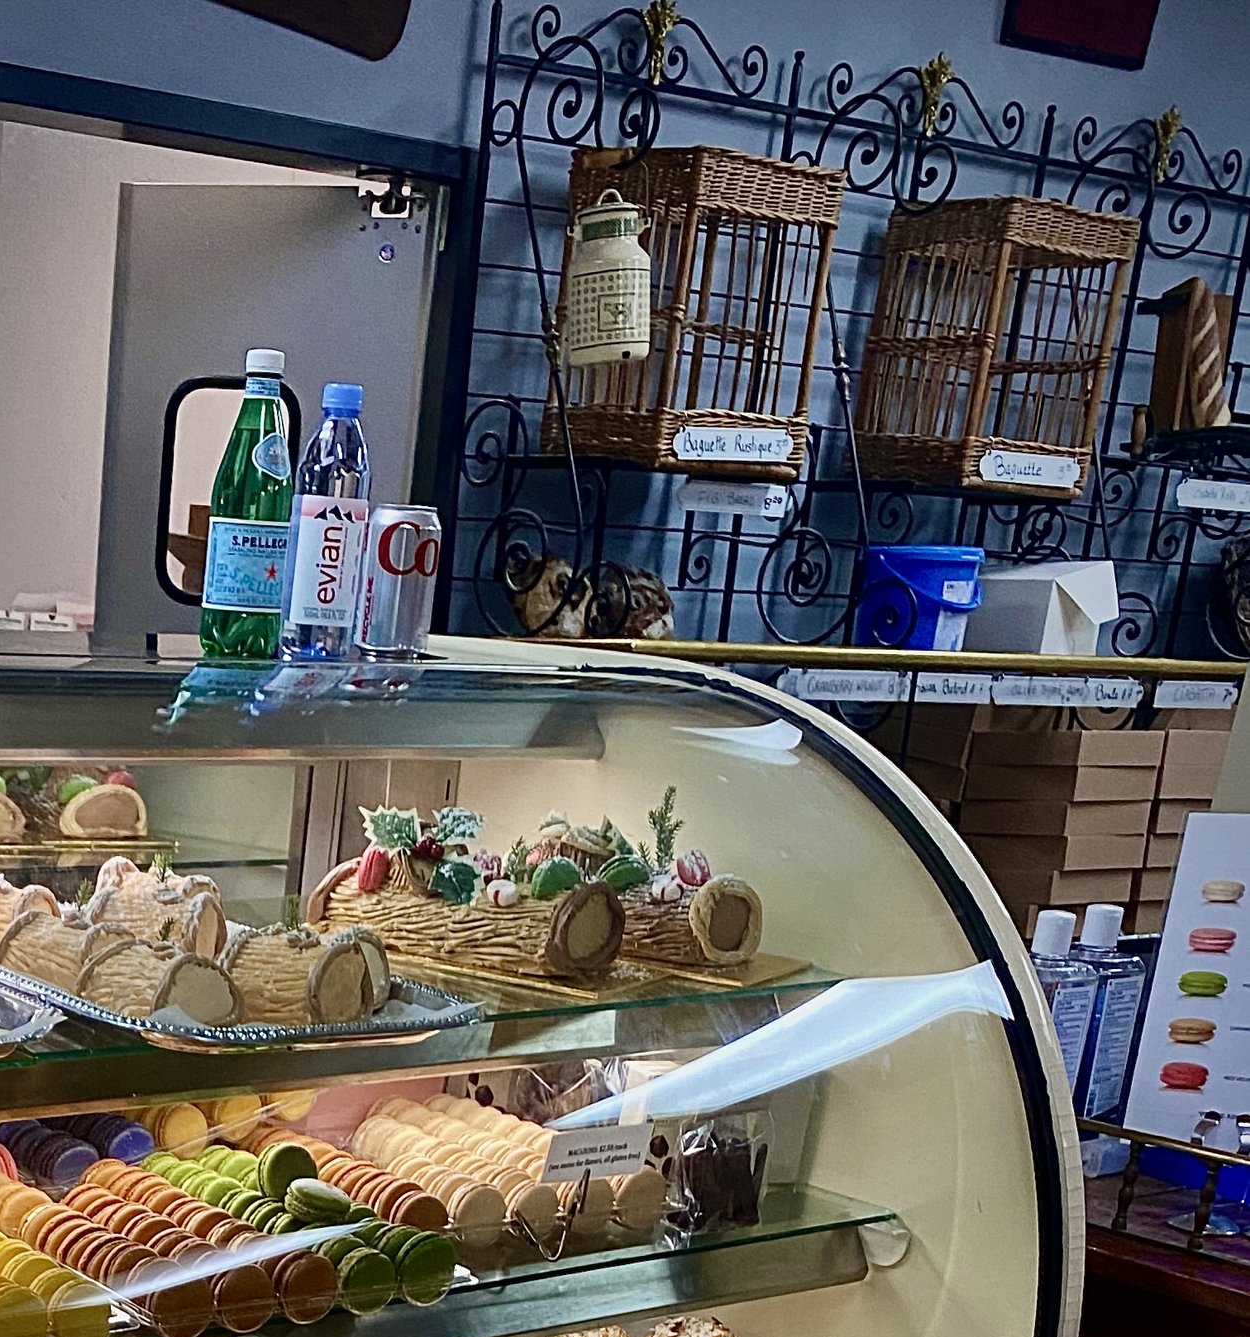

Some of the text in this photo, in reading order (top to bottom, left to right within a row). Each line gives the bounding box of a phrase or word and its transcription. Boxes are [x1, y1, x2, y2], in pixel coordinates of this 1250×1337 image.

[683, 432, 726, 457] Baguette
[734, 434, 772, 459] Rustique
[993, 455, 1042, 481] Baguette
[316, 525, 343, 605] evian
[378, 520, 439, 578] Co
